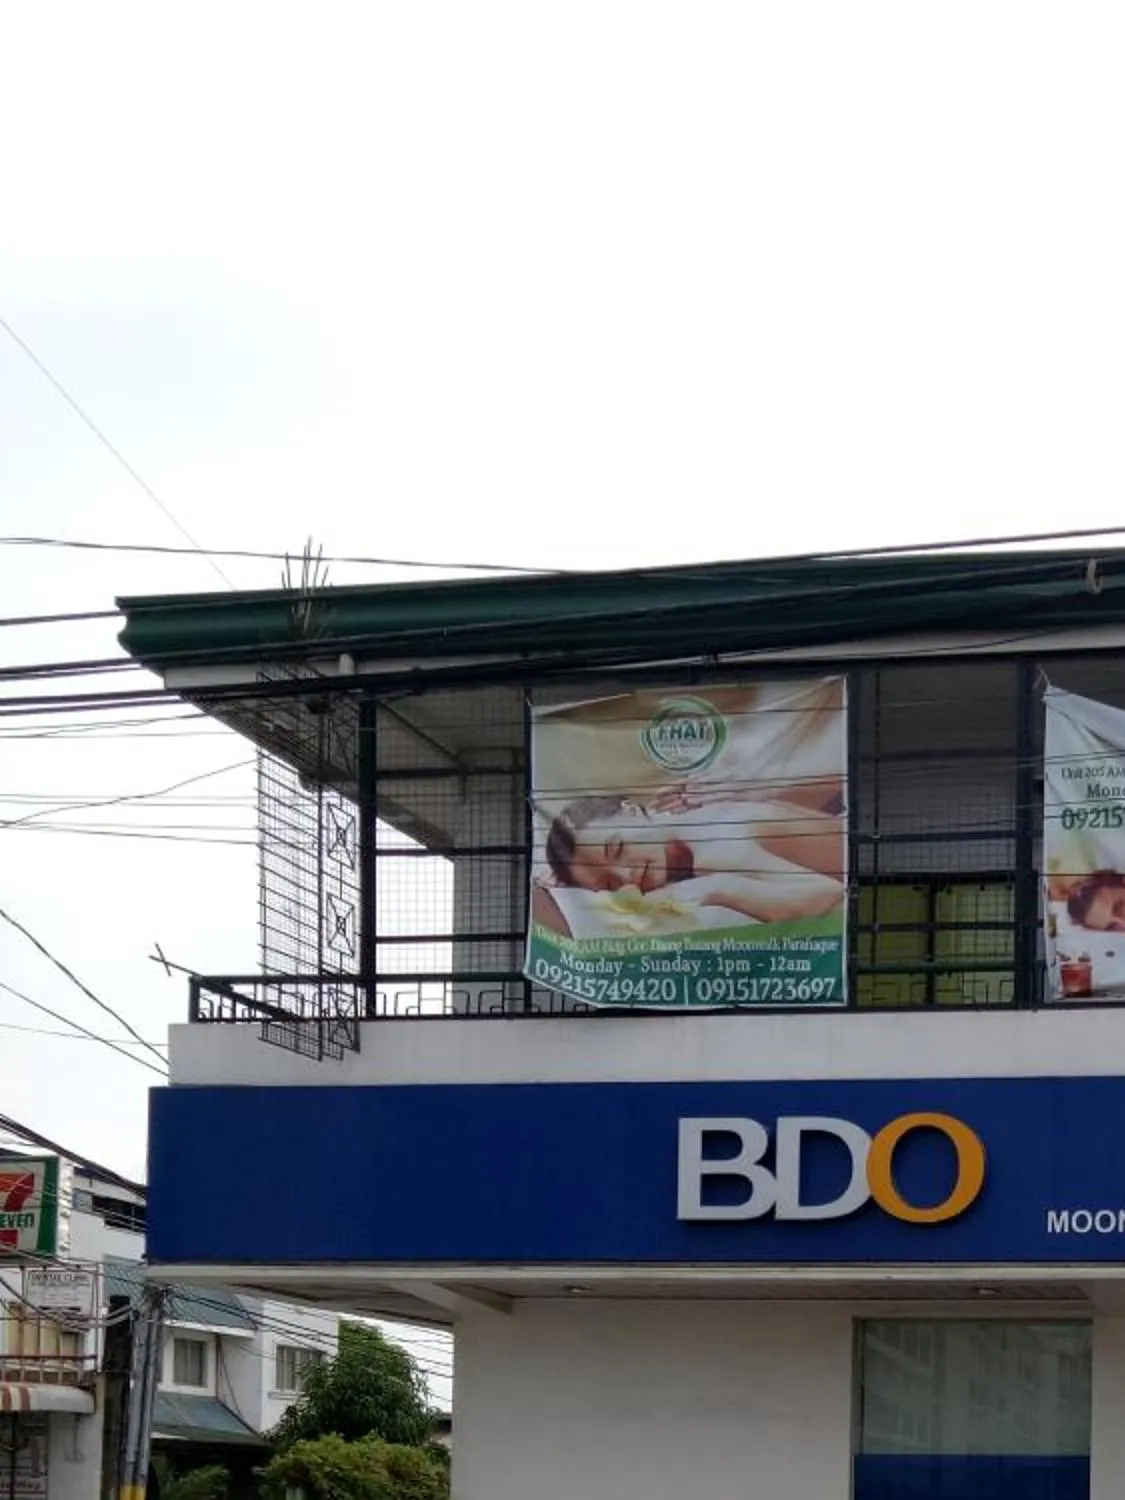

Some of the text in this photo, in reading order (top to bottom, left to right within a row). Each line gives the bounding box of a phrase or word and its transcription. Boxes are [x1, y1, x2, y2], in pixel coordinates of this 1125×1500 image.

[535, 958, 677, 1002] 09215749420
[696, 976, 836, 1002] 09151723697
[560, 951, 624, 976] Monday
[640, 955, 701, 976] Sunday
[717, 956, 751, 976] 1pm
[770, 956, 812, 972] 12am
[676, 1112, 987, 1225] BDO
